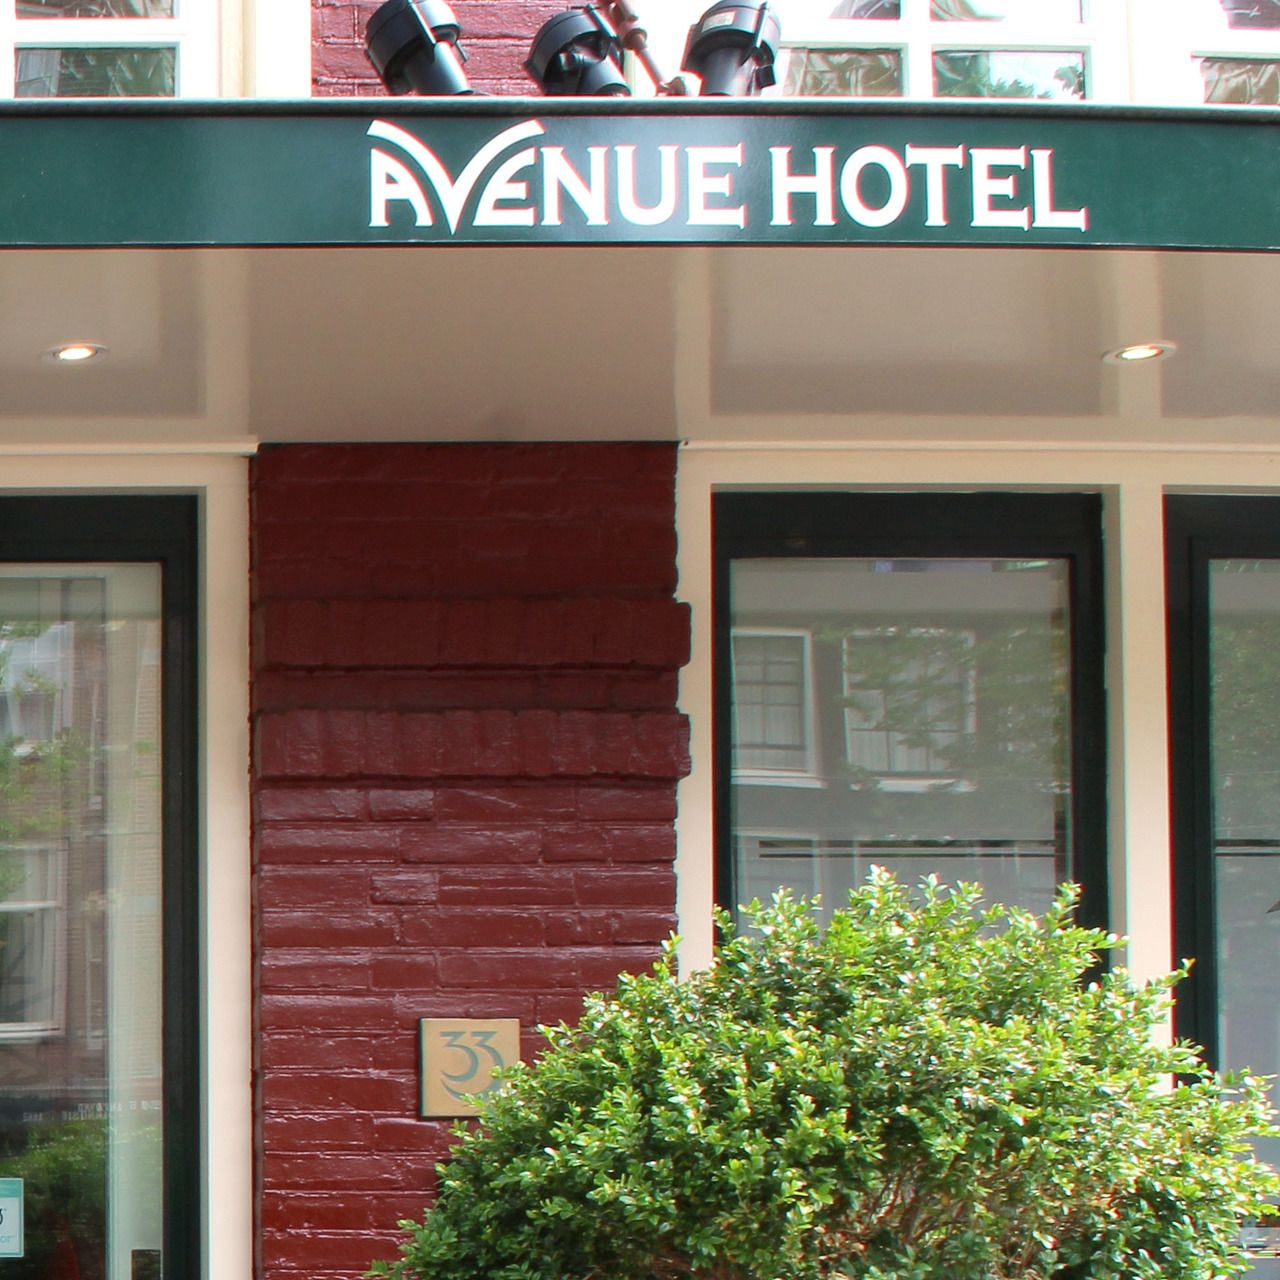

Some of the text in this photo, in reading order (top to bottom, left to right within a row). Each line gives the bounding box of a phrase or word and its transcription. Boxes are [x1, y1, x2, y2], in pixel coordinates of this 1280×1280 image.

[367, 118, 1088, 235] AVENUE HOTEL
[440, 1031, 505, 1106] 33
